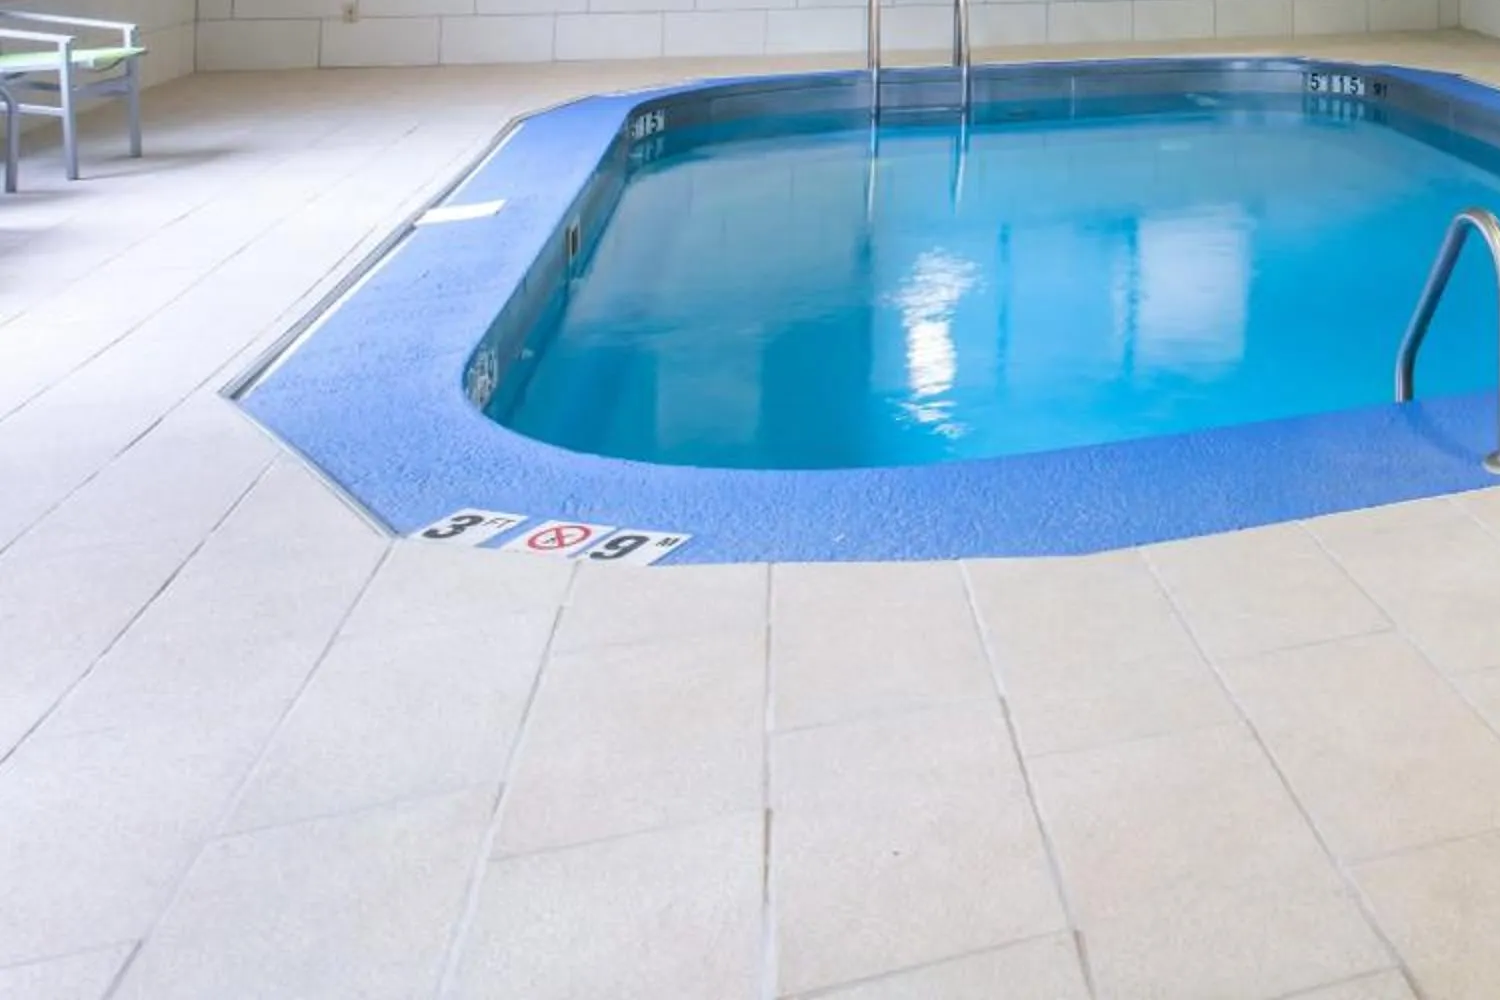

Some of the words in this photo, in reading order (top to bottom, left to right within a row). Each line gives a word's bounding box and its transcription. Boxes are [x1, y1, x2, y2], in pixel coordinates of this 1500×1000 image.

[421, 515, 483, 539] 3
[483, 518, 516, 529] FT
[589, 535, 650, 560] 9
